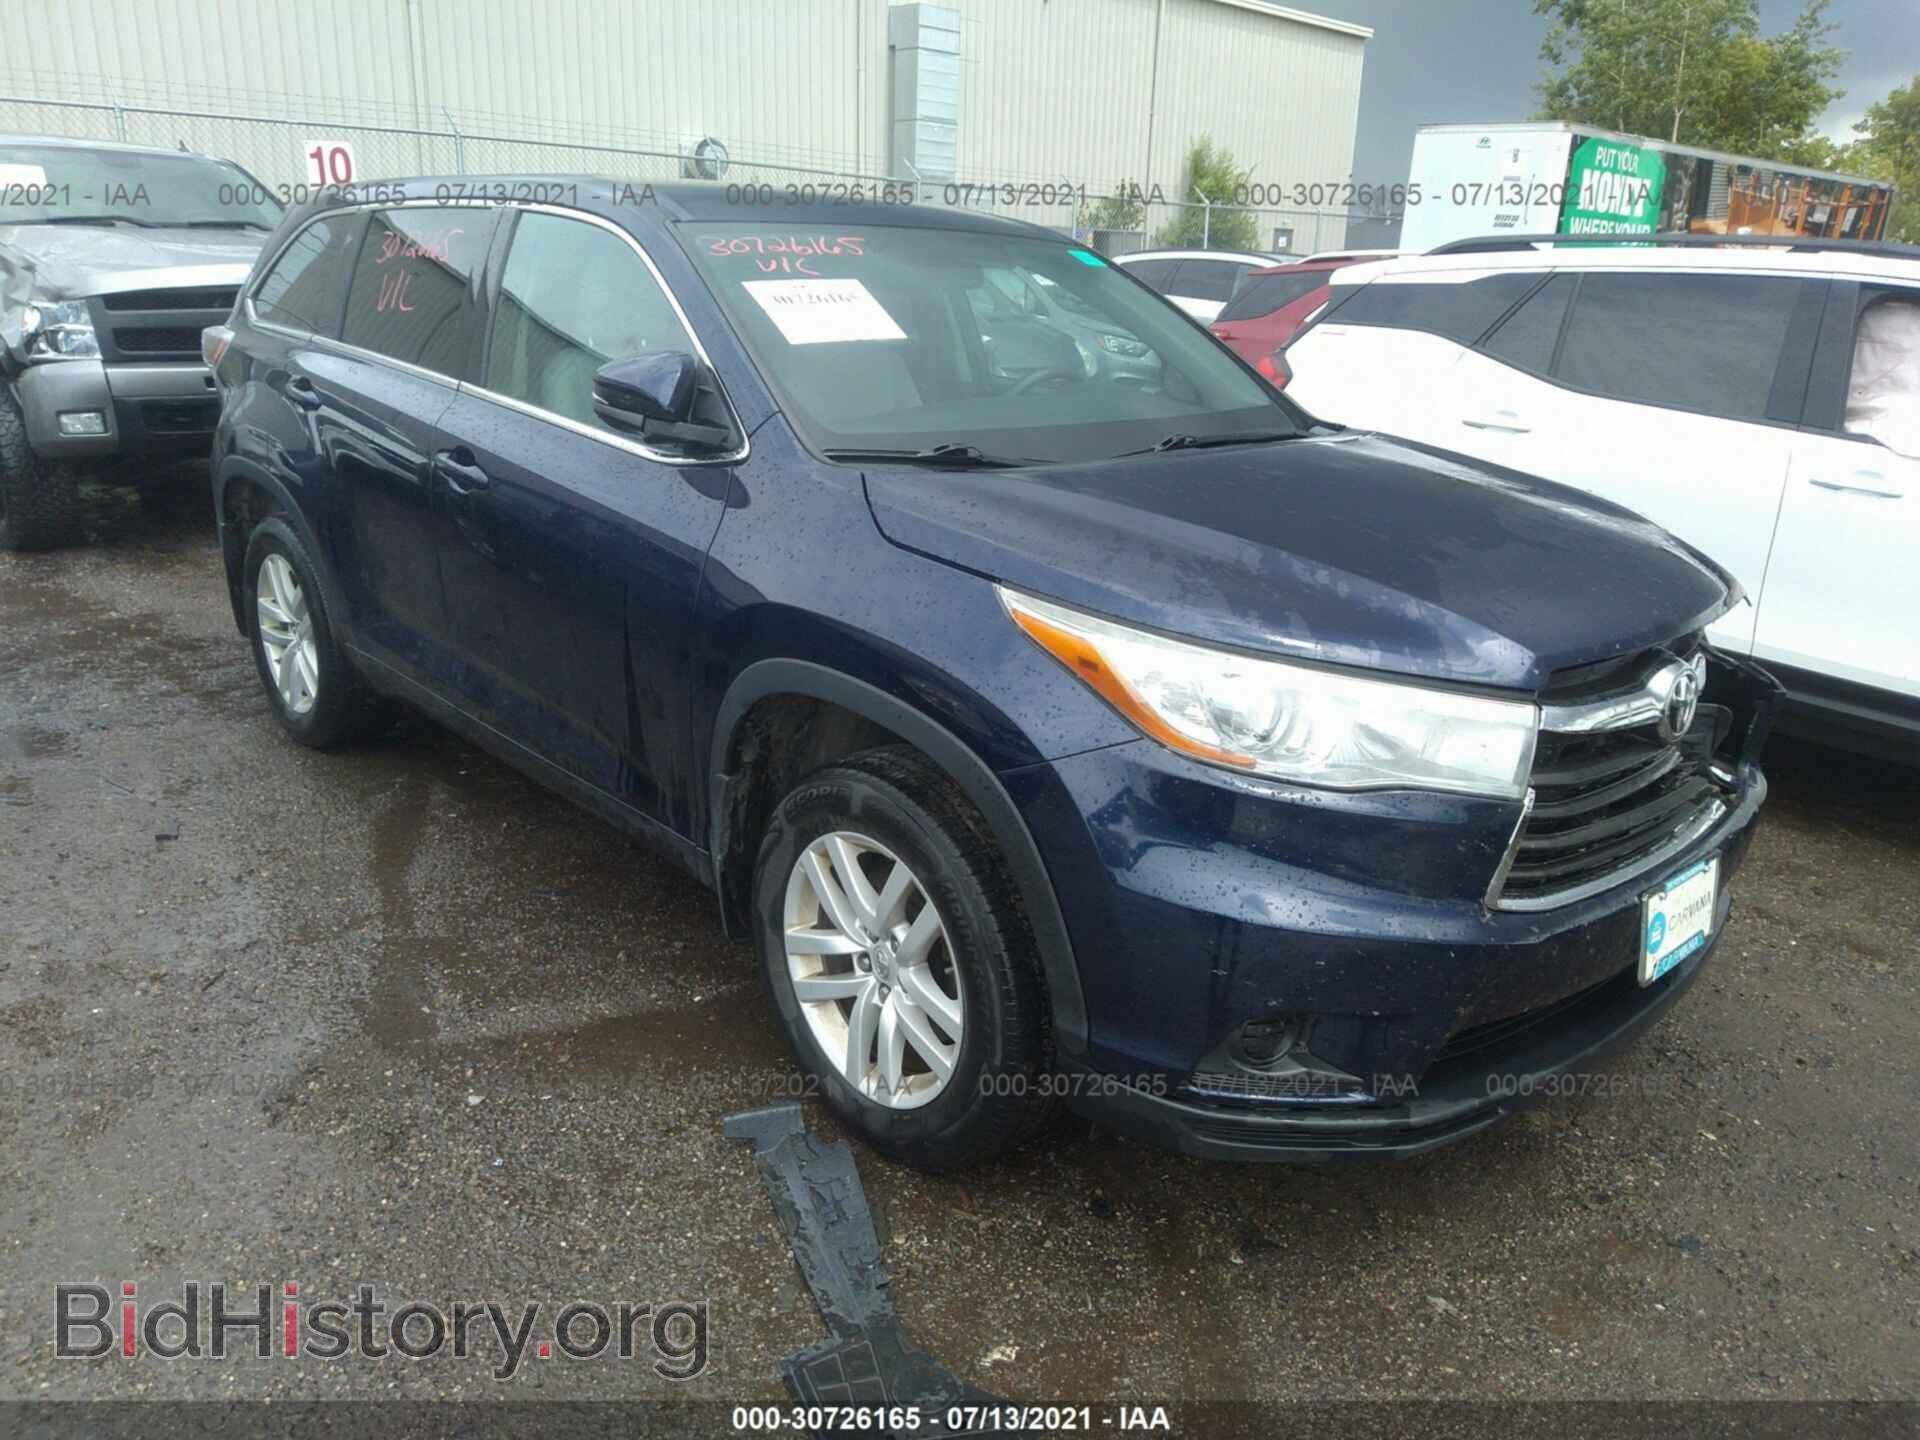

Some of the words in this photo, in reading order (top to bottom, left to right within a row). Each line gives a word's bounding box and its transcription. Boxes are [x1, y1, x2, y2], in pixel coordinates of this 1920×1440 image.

[309, 146, 352, 185] 10
[1595, 146, 1617, 169] PUT
[1617, 150, 1640, 174] YOUR
[1577, 168, 1653, 218] MONEY
[709, 235, 865, 257] 30726165
